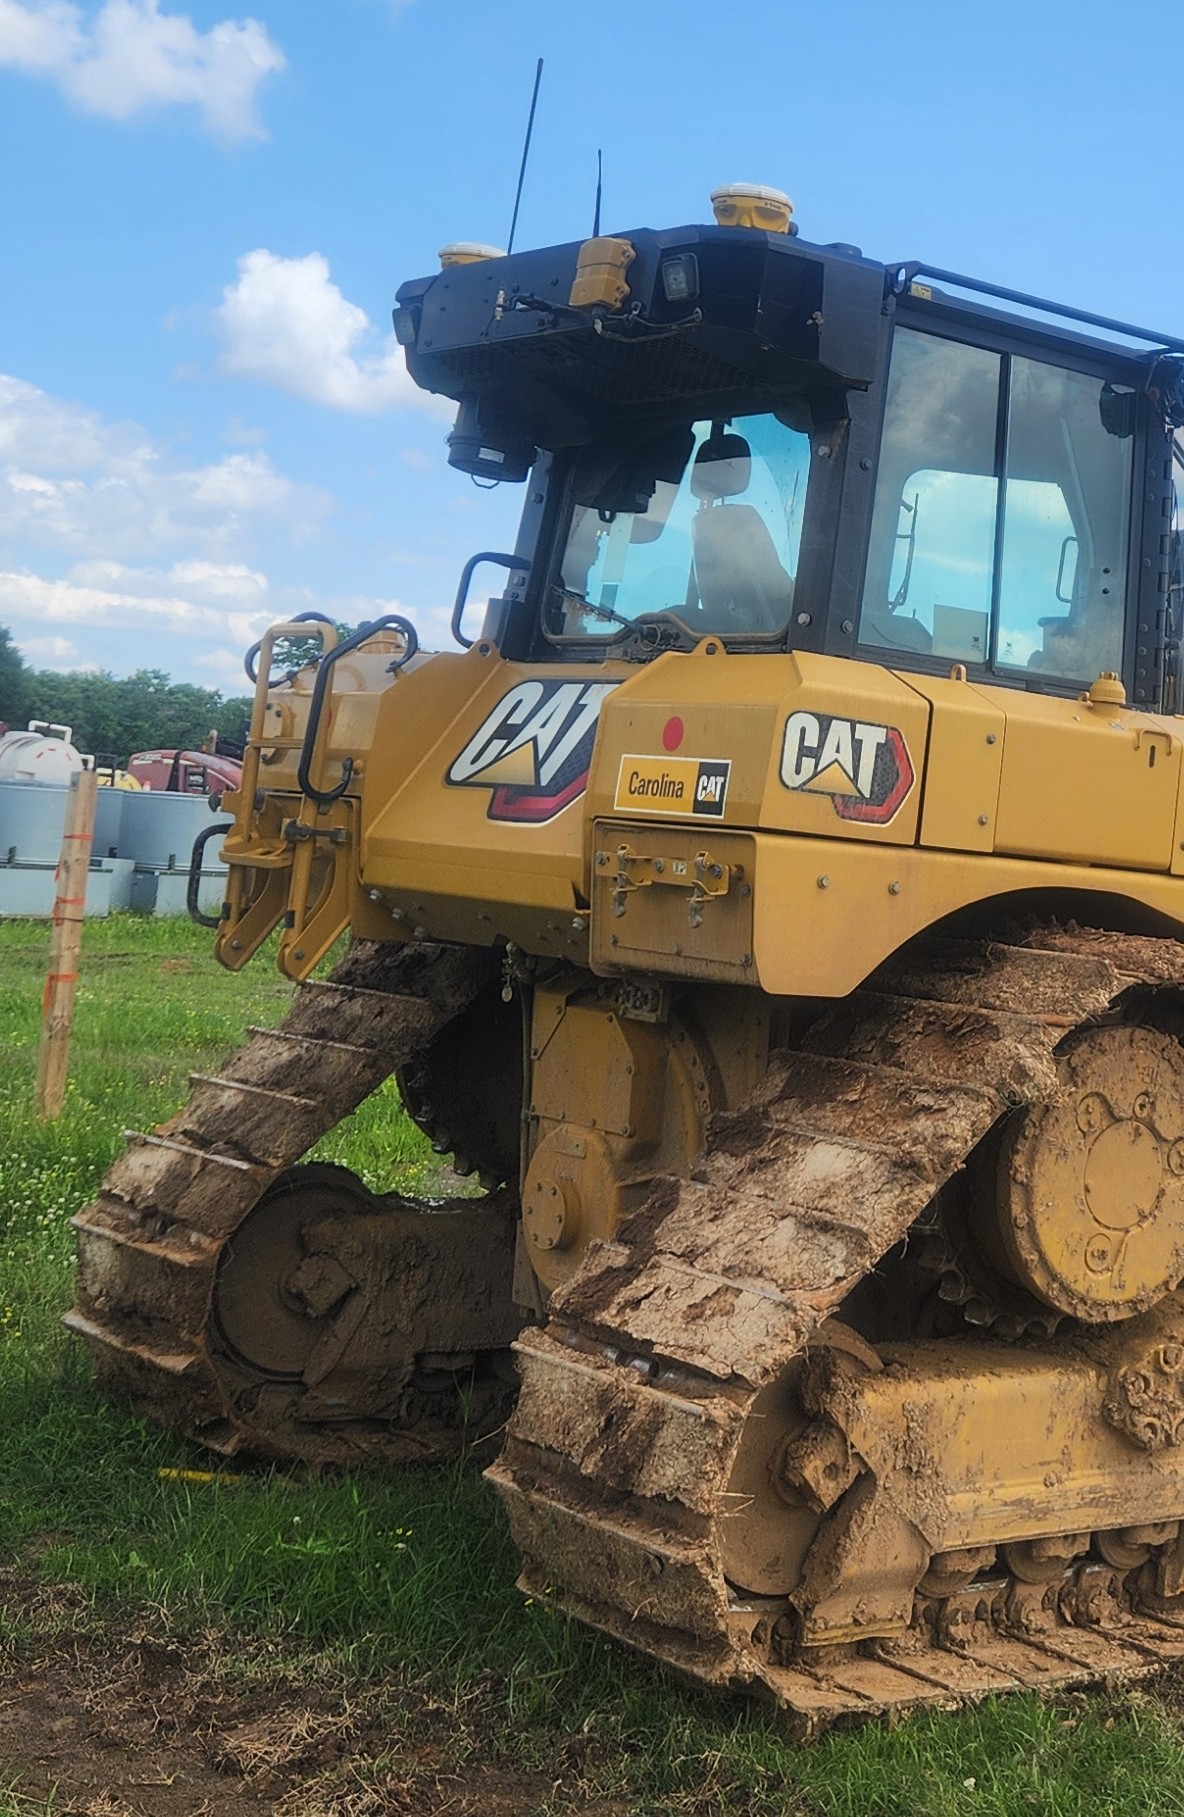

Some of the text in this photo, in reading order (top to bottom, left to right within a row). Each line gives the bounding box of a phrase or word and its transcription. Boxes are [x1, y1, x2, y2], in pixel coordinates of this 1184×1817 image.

[450, 681, 620, 786] CAT
[781, 712, 887, 799] CAT
[628, 771, 725, 803] Carolina CAT
